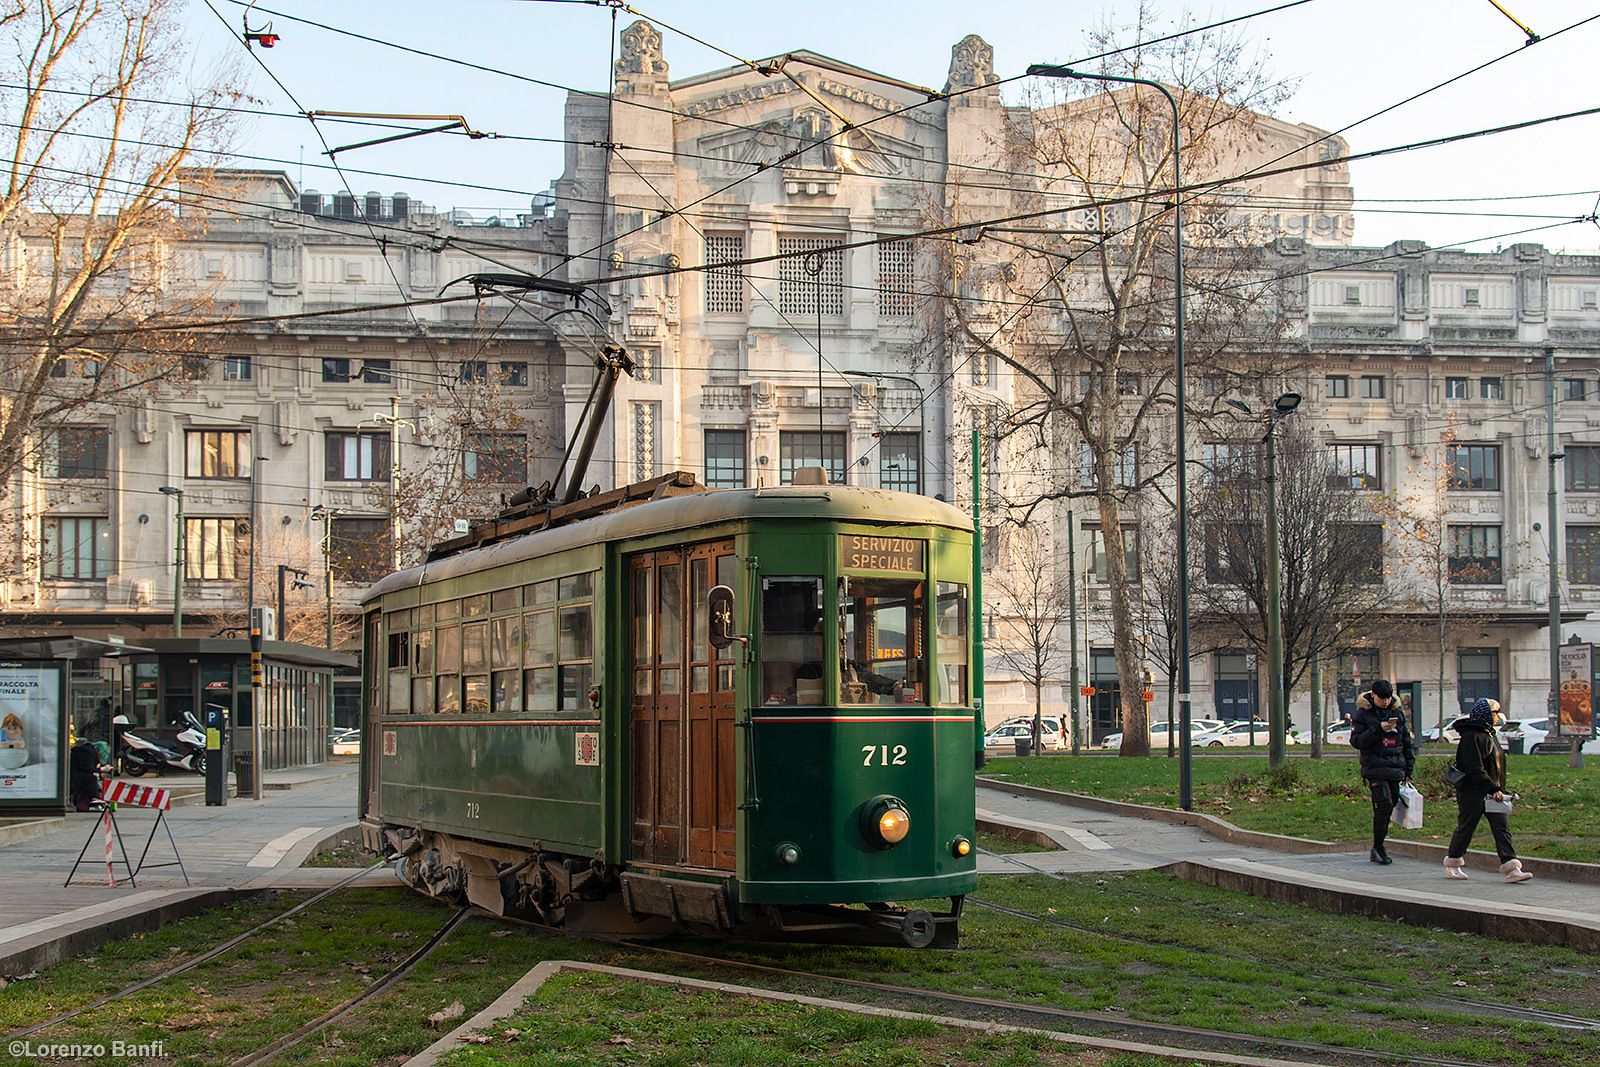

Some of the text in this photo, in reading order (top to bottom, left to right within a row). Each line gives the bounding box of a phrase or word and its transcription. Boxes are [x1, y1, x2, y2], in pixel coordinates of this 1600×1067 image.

[852, 536, 914, 553] SERVIZIO
[851, 554, 914, 570] SPECIALE
[208, 712, 216, 722] P
[861, 745, 908, 766] 712
[466, 802, 480, 819] 712
